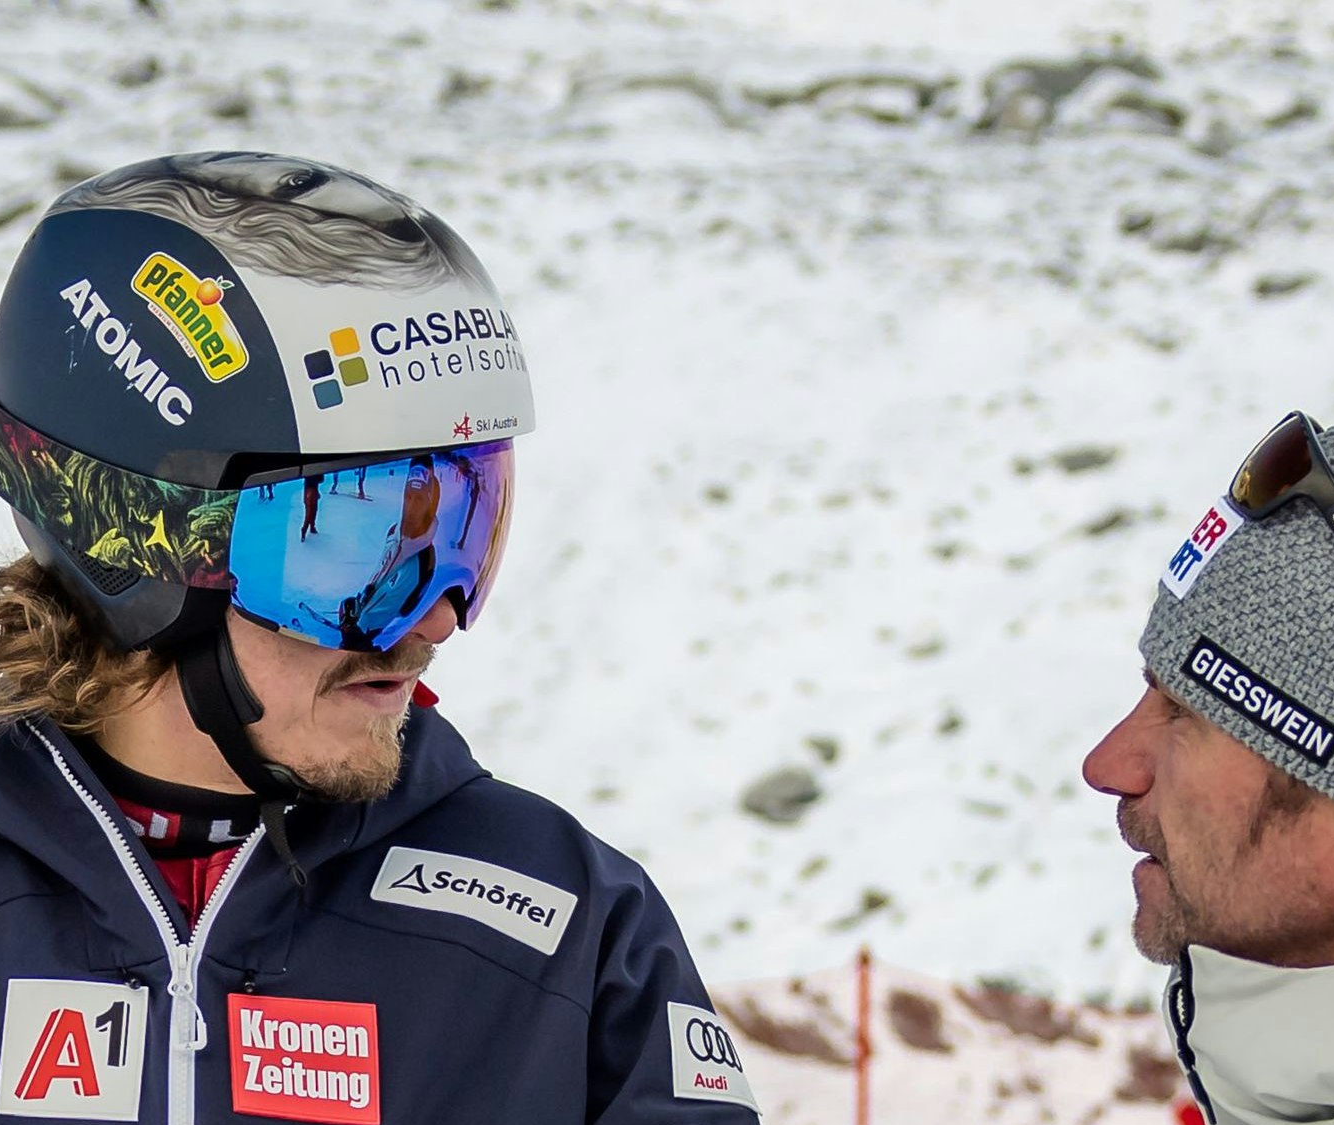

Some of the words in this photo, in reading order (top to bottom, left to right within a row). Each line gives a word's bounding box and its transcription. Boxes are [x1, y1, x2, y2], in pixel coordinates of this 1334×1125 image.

[59, 278, 193, 426] ATOMIC
[476, 420, 491, 432] Ski
[493, 416, 518, 431] Austria
[1191, 648, 1333, 757] GIESSWEIN
[14, 1000, 132, 1100] A1
[239, 1008, 369, 1058] Kronen
[243, 1054, 370, 1109] Zeitung
[694, 1072, 728, 1091] Audi
